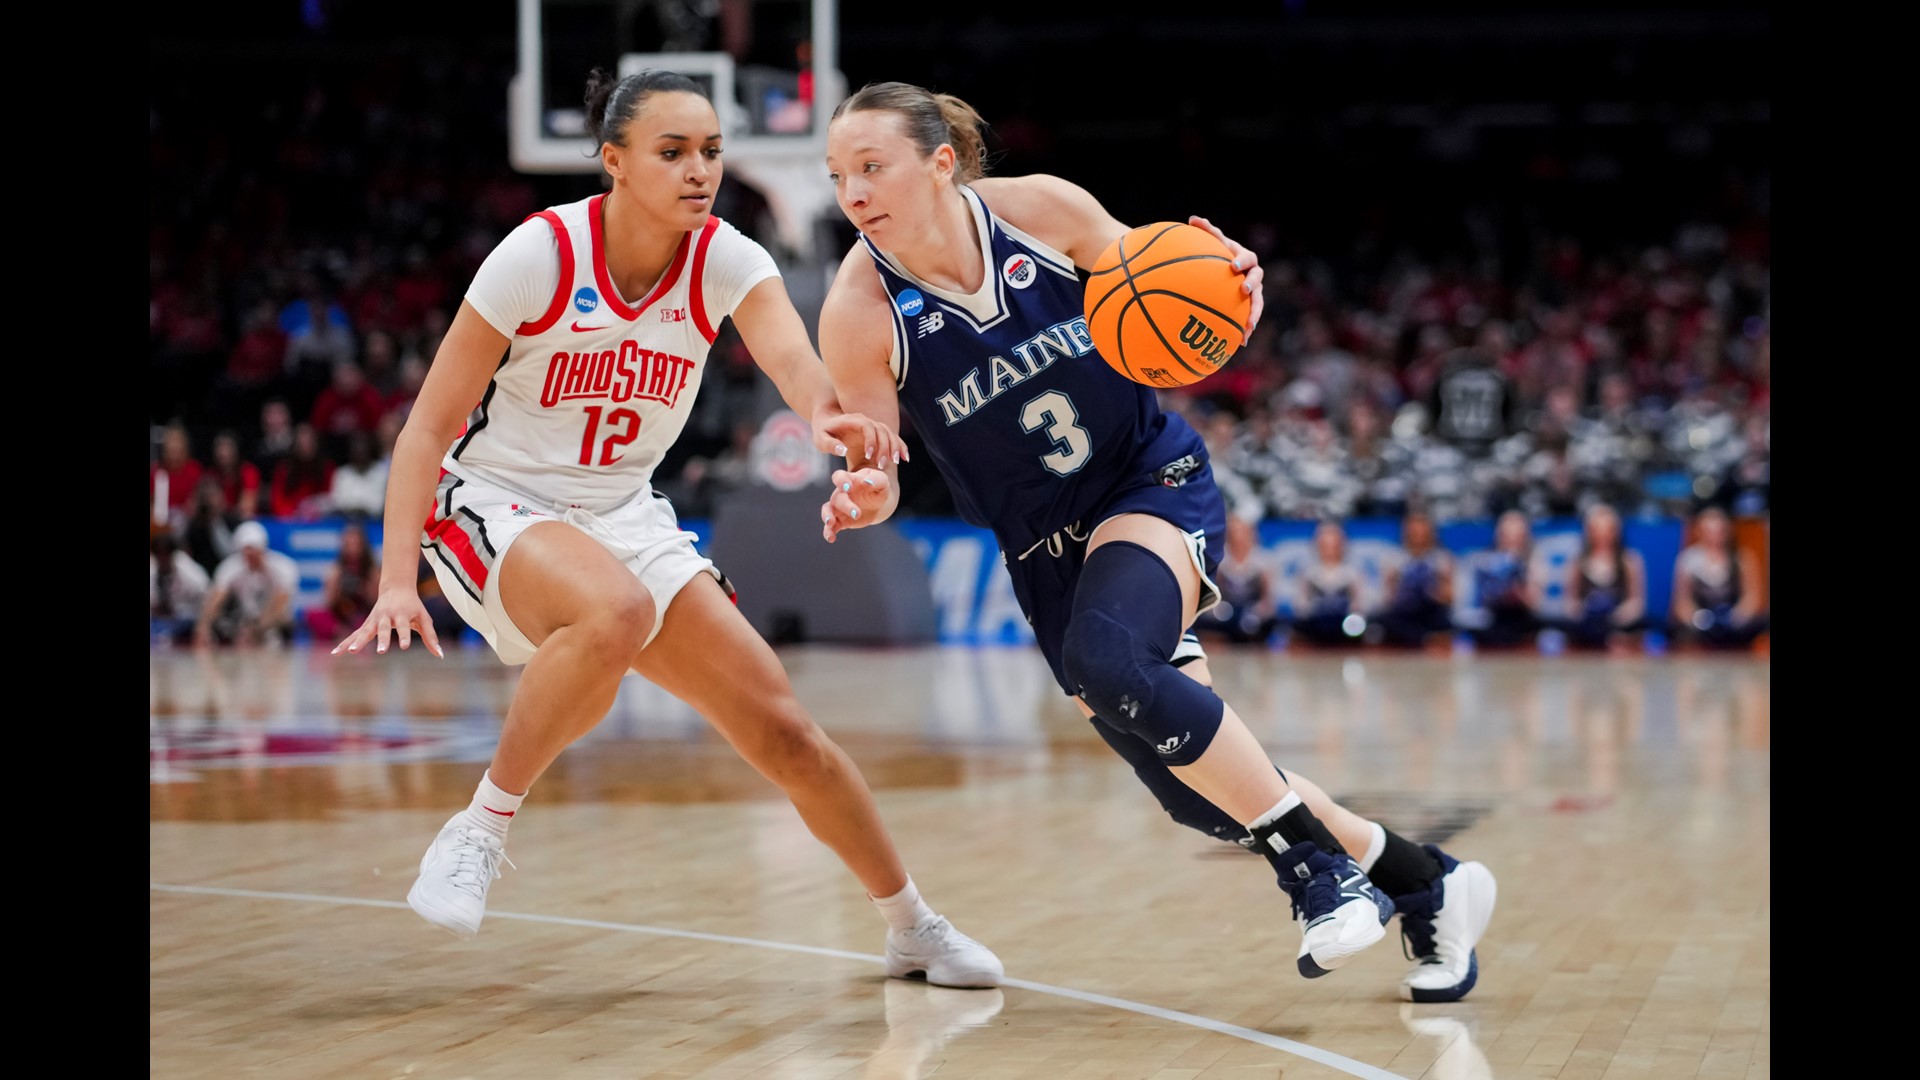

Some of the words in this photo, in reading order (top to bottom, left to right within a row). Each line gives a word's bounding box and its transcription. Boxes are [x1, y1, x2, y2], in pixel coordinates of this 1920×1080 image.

[577, 297, 596, 308] NCAA
[901, 298, 923, 312] NCAA
[935, 315, 1096, 427] MAINE
[578, 405, 642, 467] 12
[1018, 389, 1093, 478] 3
